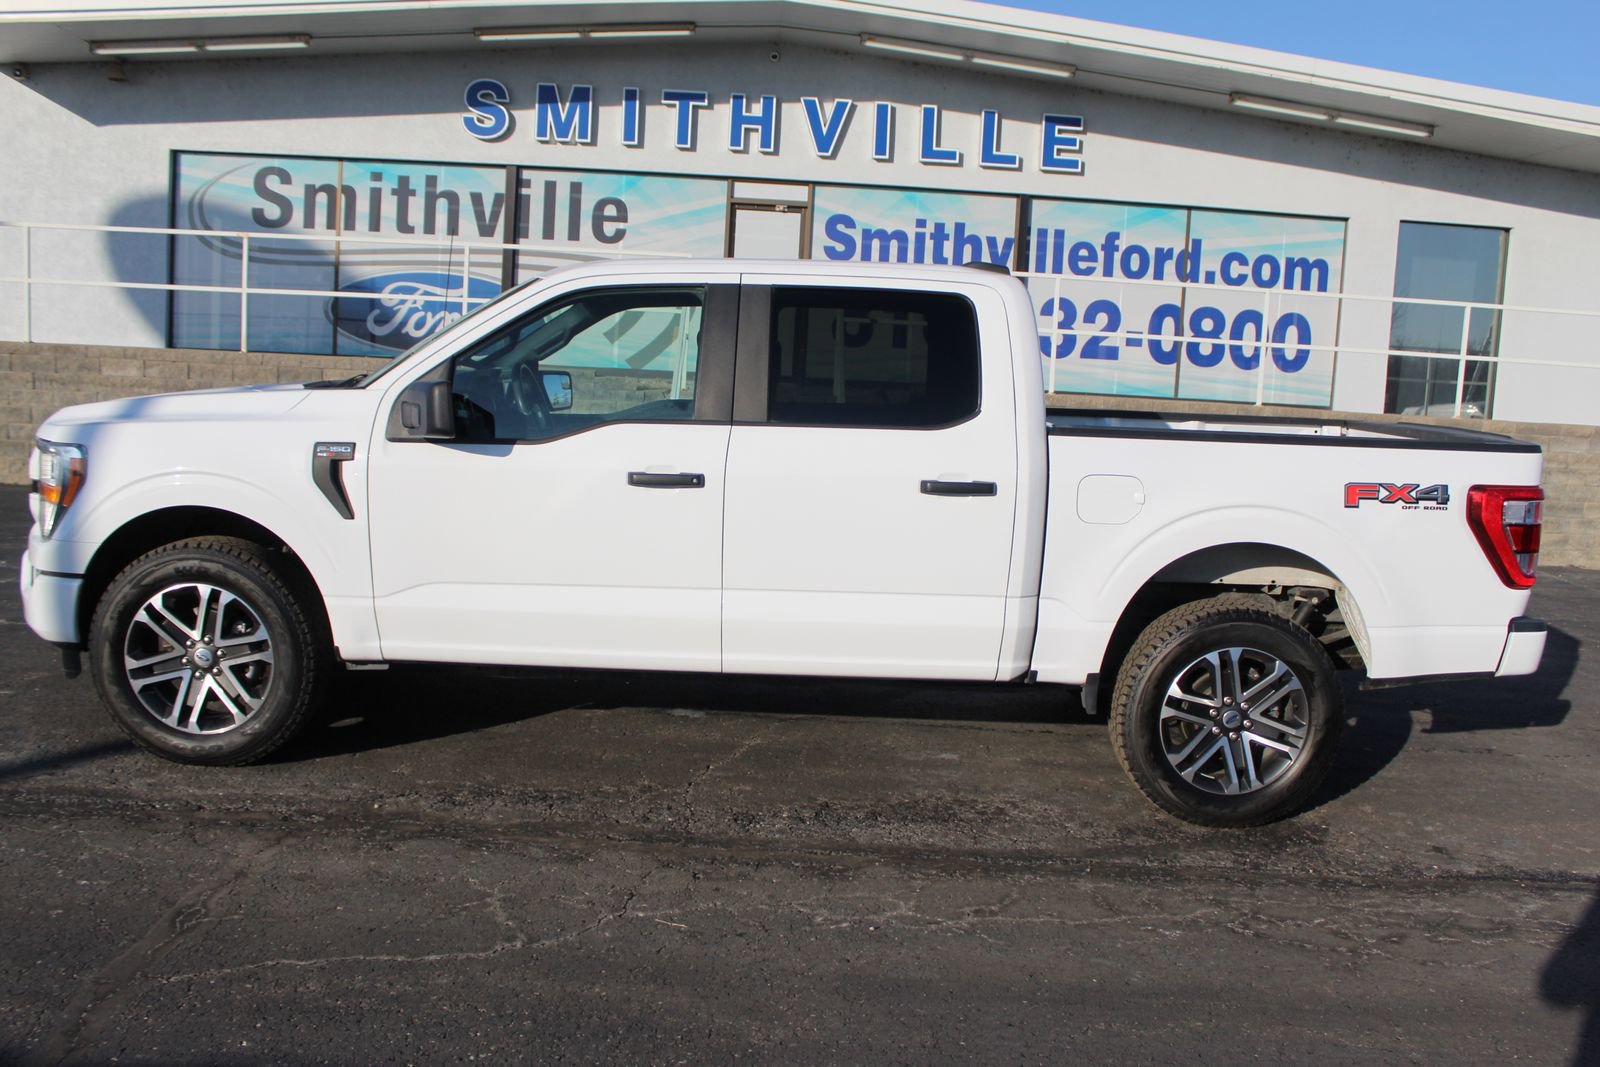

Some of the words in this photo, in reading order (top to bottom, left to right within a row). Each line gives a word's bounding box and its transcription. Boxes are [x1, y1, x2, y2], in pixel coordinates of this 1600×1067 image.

[463, 79, 1087, 173] SMITHVILLE
[251, 166, 629, 244] Smithville
[823, 213, 1329, 292] Smithvlleford.com
[366, 281, 464, 338] For
[1343, 482, 1450, 508] FX4
